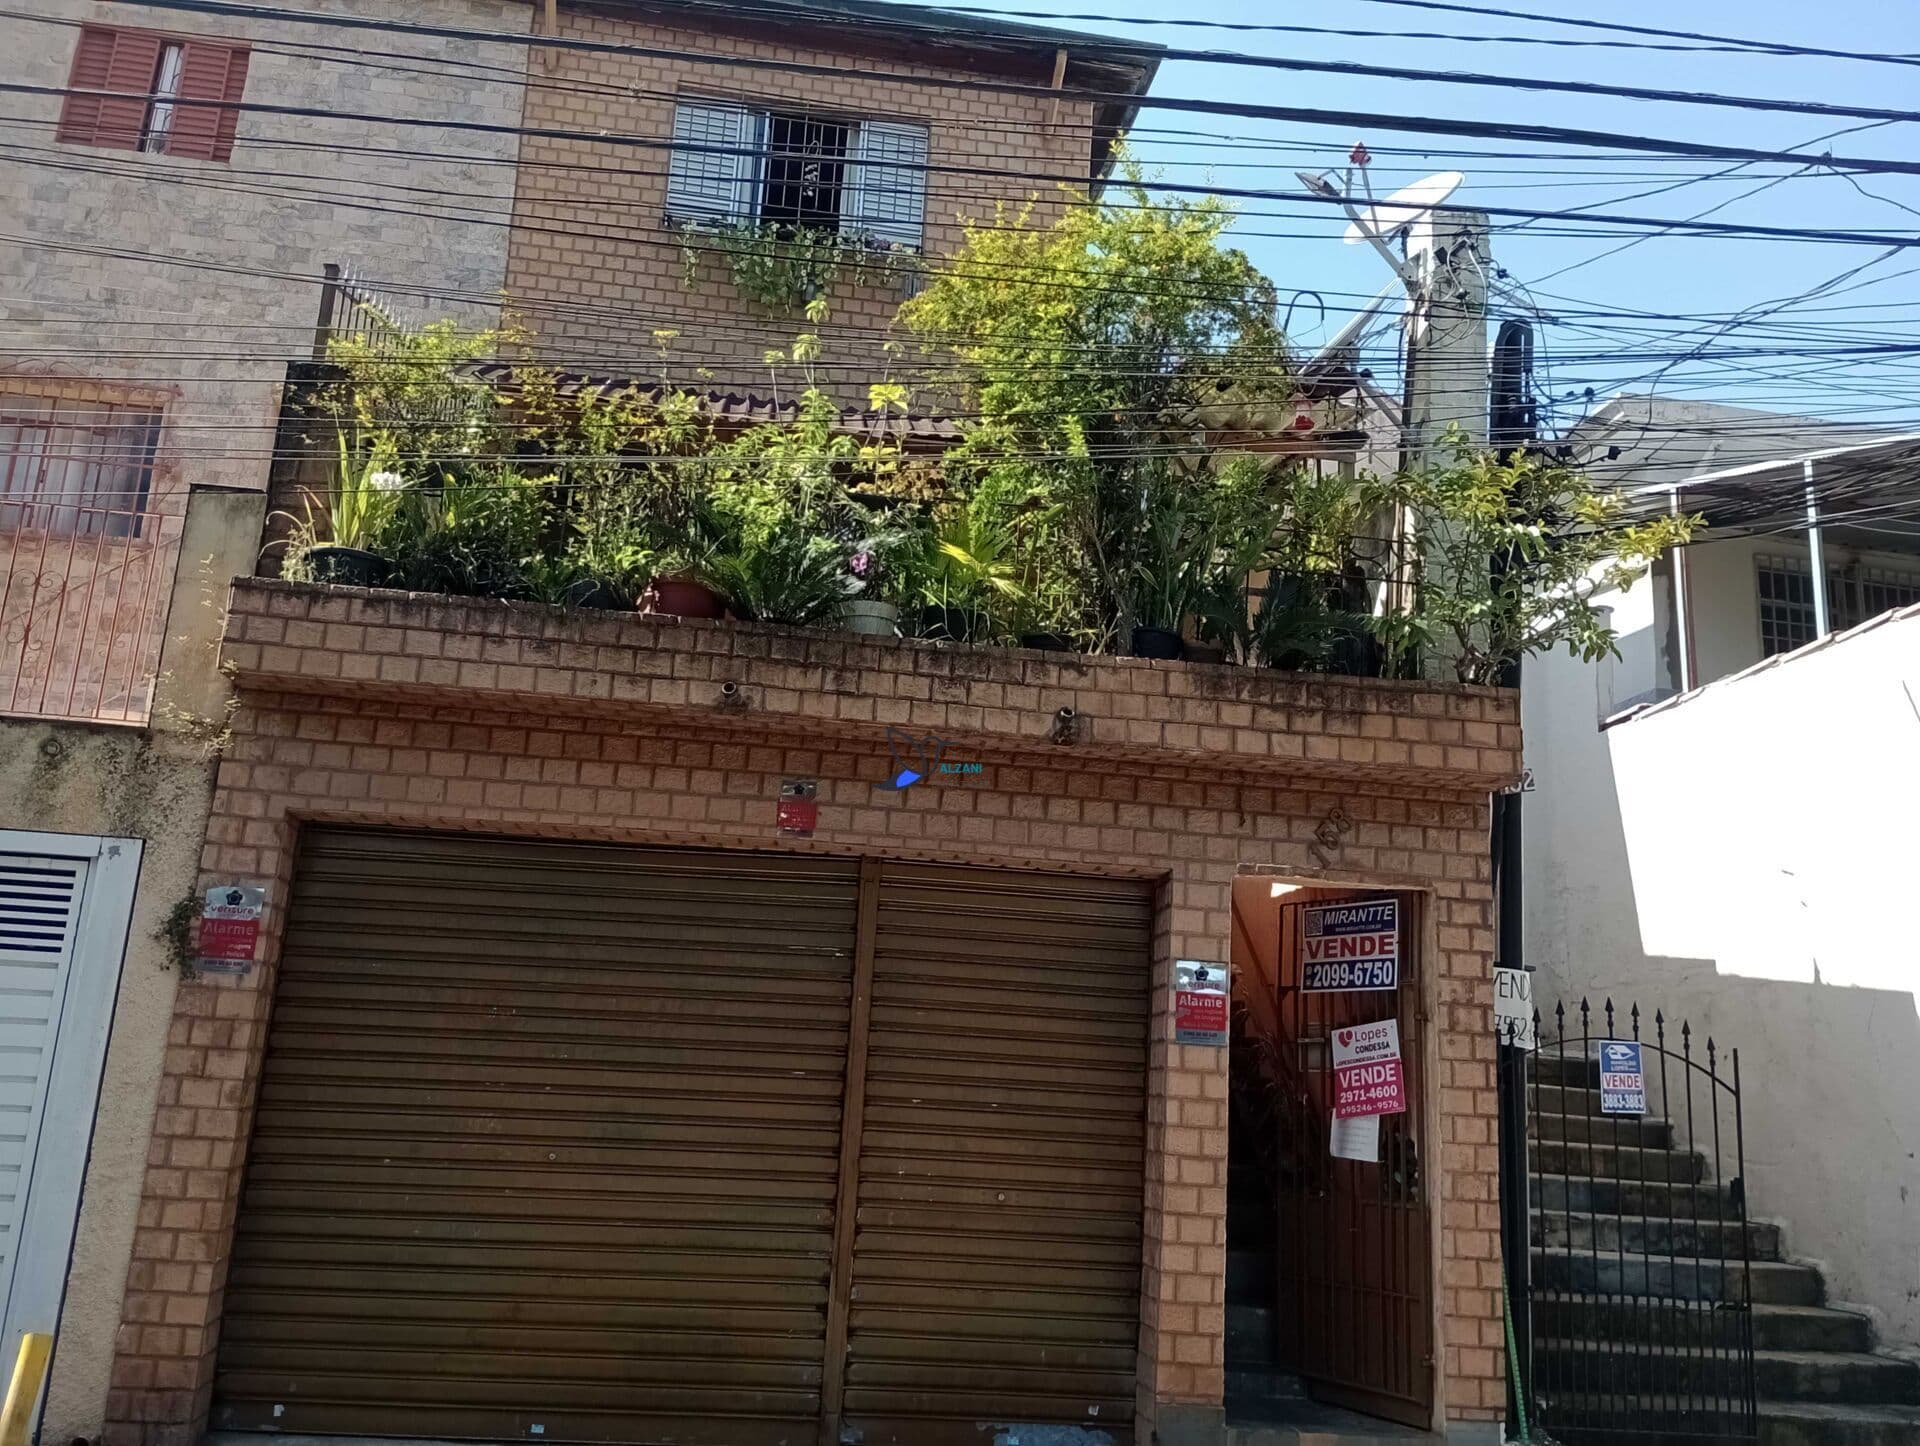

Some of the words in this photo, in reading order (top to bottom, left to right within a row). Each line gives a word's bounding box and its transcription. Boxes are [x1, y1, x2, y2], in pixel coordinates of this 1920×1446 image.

[1310, 808, 1351, 868] 158
[211, 904, 255, 914] verisure
[1324, 905, 1394, 926] MIRANTTE
[203, 922, 254, 936] Alarme
[1306, 934, 1395, 960] VENDE
[1313, 961, 1393, 987] 2099-6750
[1179, 994, 1223, 1008] Alarme
[1354, 1027, 1388, 1043] Lopes
[1354, 1041, 1391, 1055] CONDESSA
[1339, 1063, 1397, 1089] VENDE
[1605, 1075, 1641, 1089] VENDE
[1340, 1084, 1398, 1104] 2971-4600
